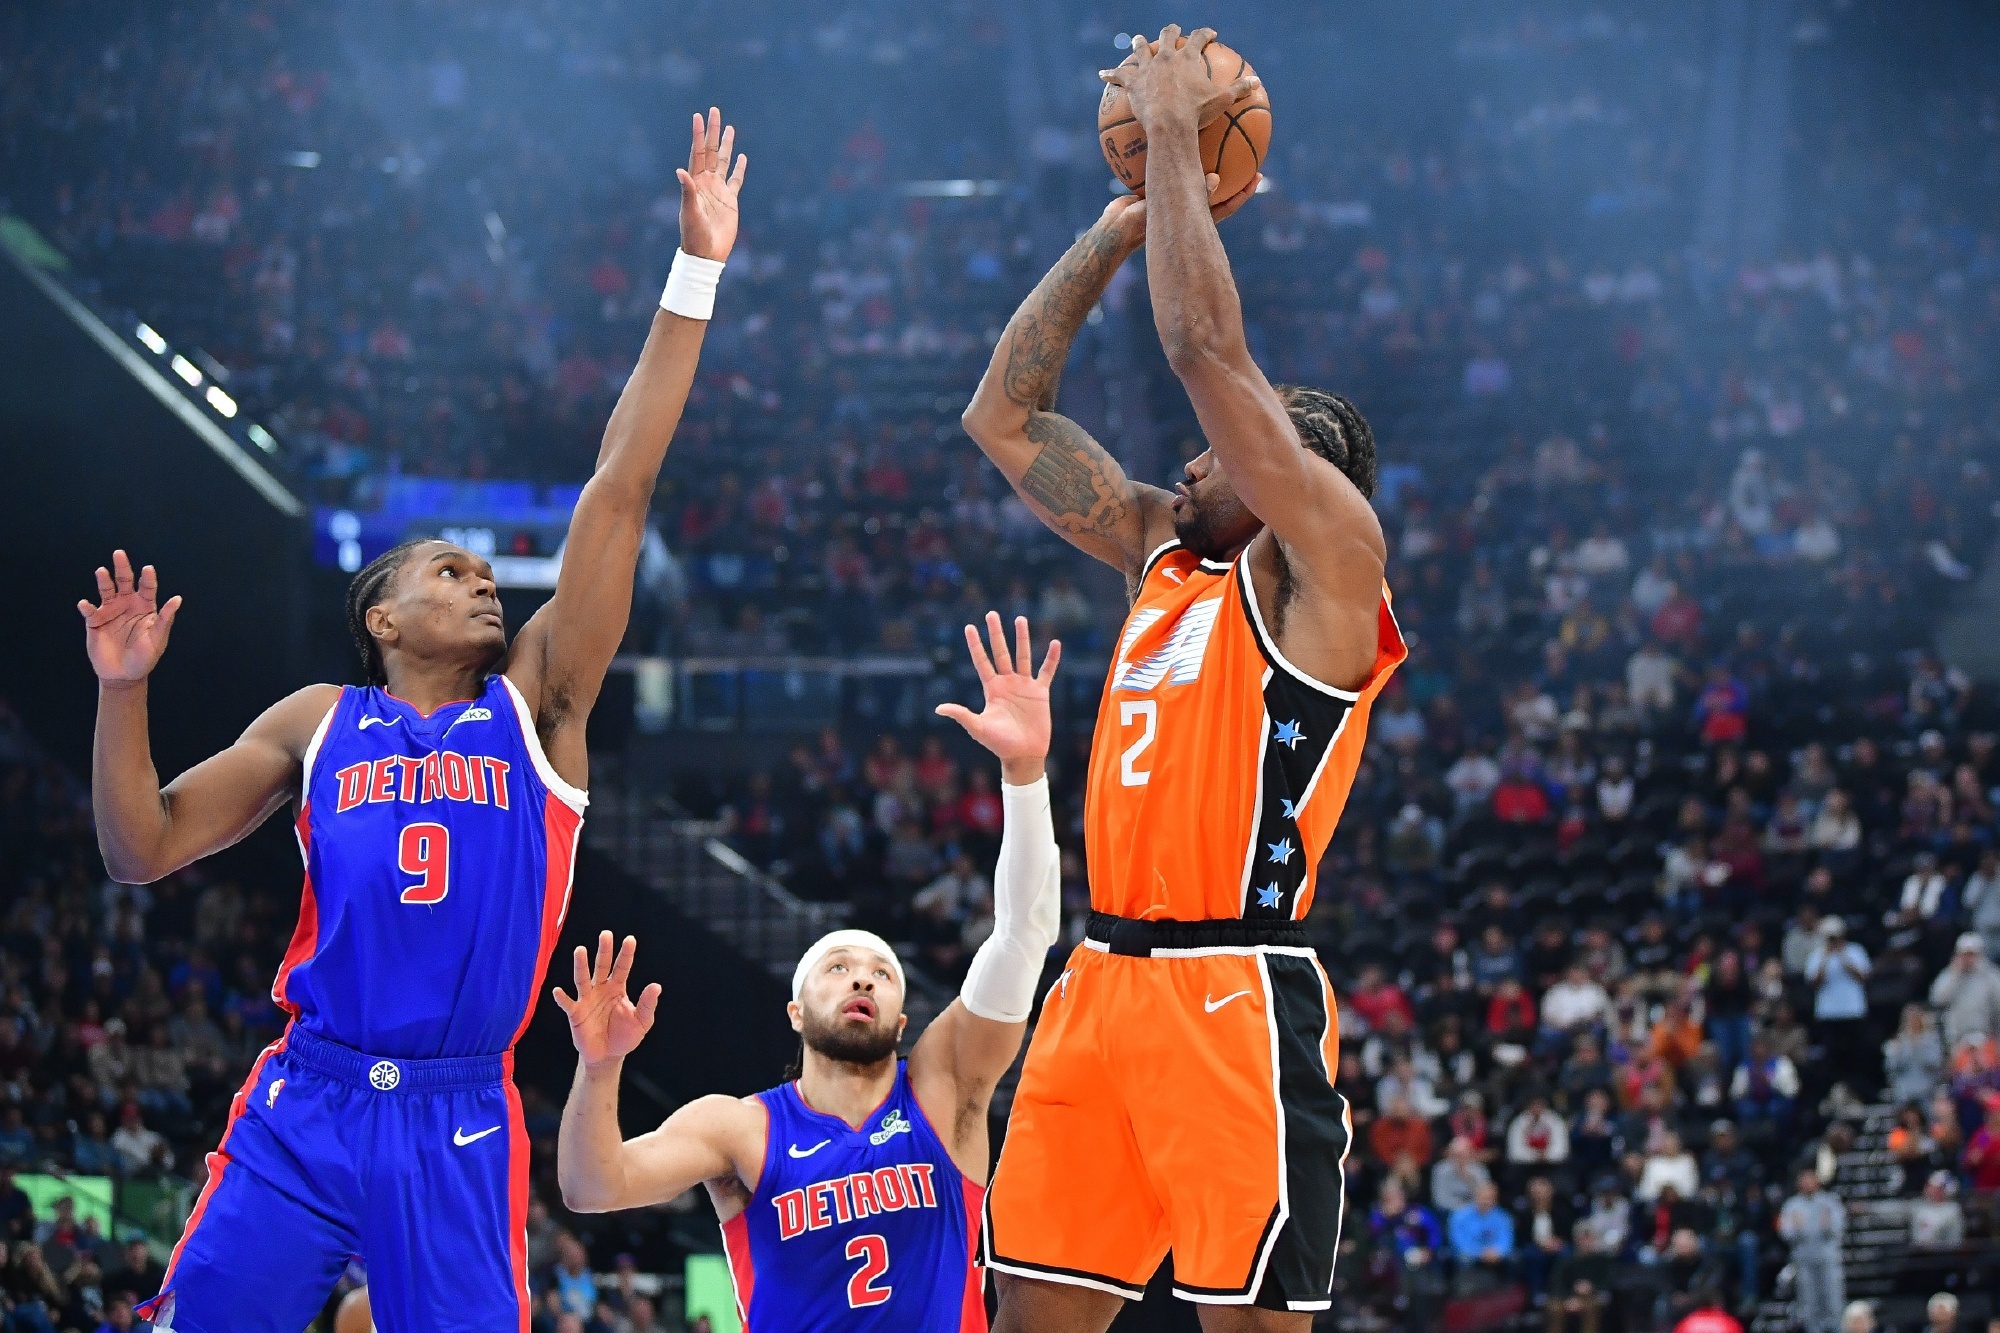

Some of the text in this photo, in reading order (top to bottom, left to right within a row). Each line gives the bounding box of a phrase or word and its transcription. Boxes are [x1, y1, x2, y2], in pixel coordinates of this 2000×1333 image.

[1119, 699, 1157, 787] 2
[335, 751, 510, 814] DETROIT
[398, 821, 449, 904] 9
[771, 1163, 938, 1241] DETROIT
[845, 1234, 892, 1309] 2
